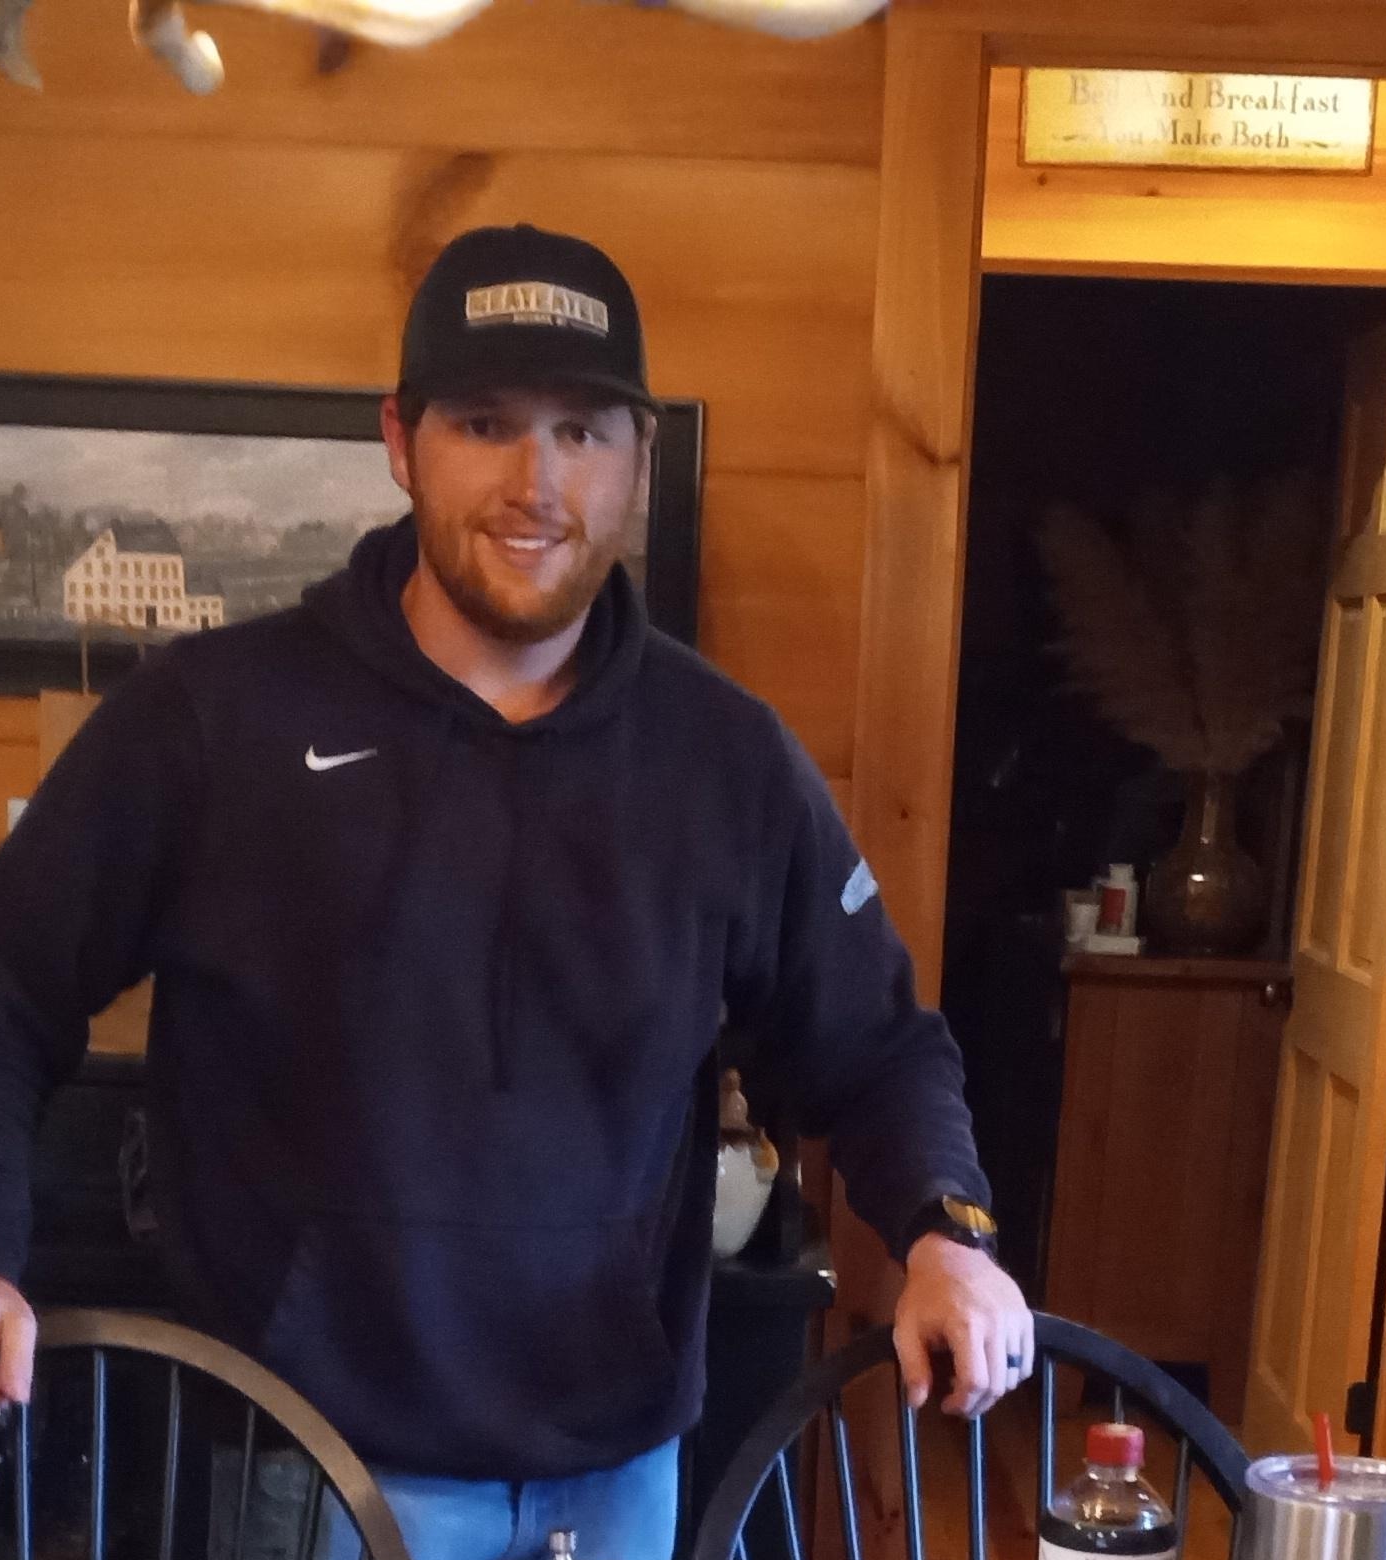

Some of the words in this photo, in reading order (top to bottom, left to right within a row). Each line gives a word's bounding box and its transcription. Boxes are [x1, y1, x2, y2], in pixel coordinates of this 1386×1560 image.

[1204, 77, 1341, 116] Breakfast
[1155, 118, 1223, 148] Make
[1231, 121, 1291, 150] Both
